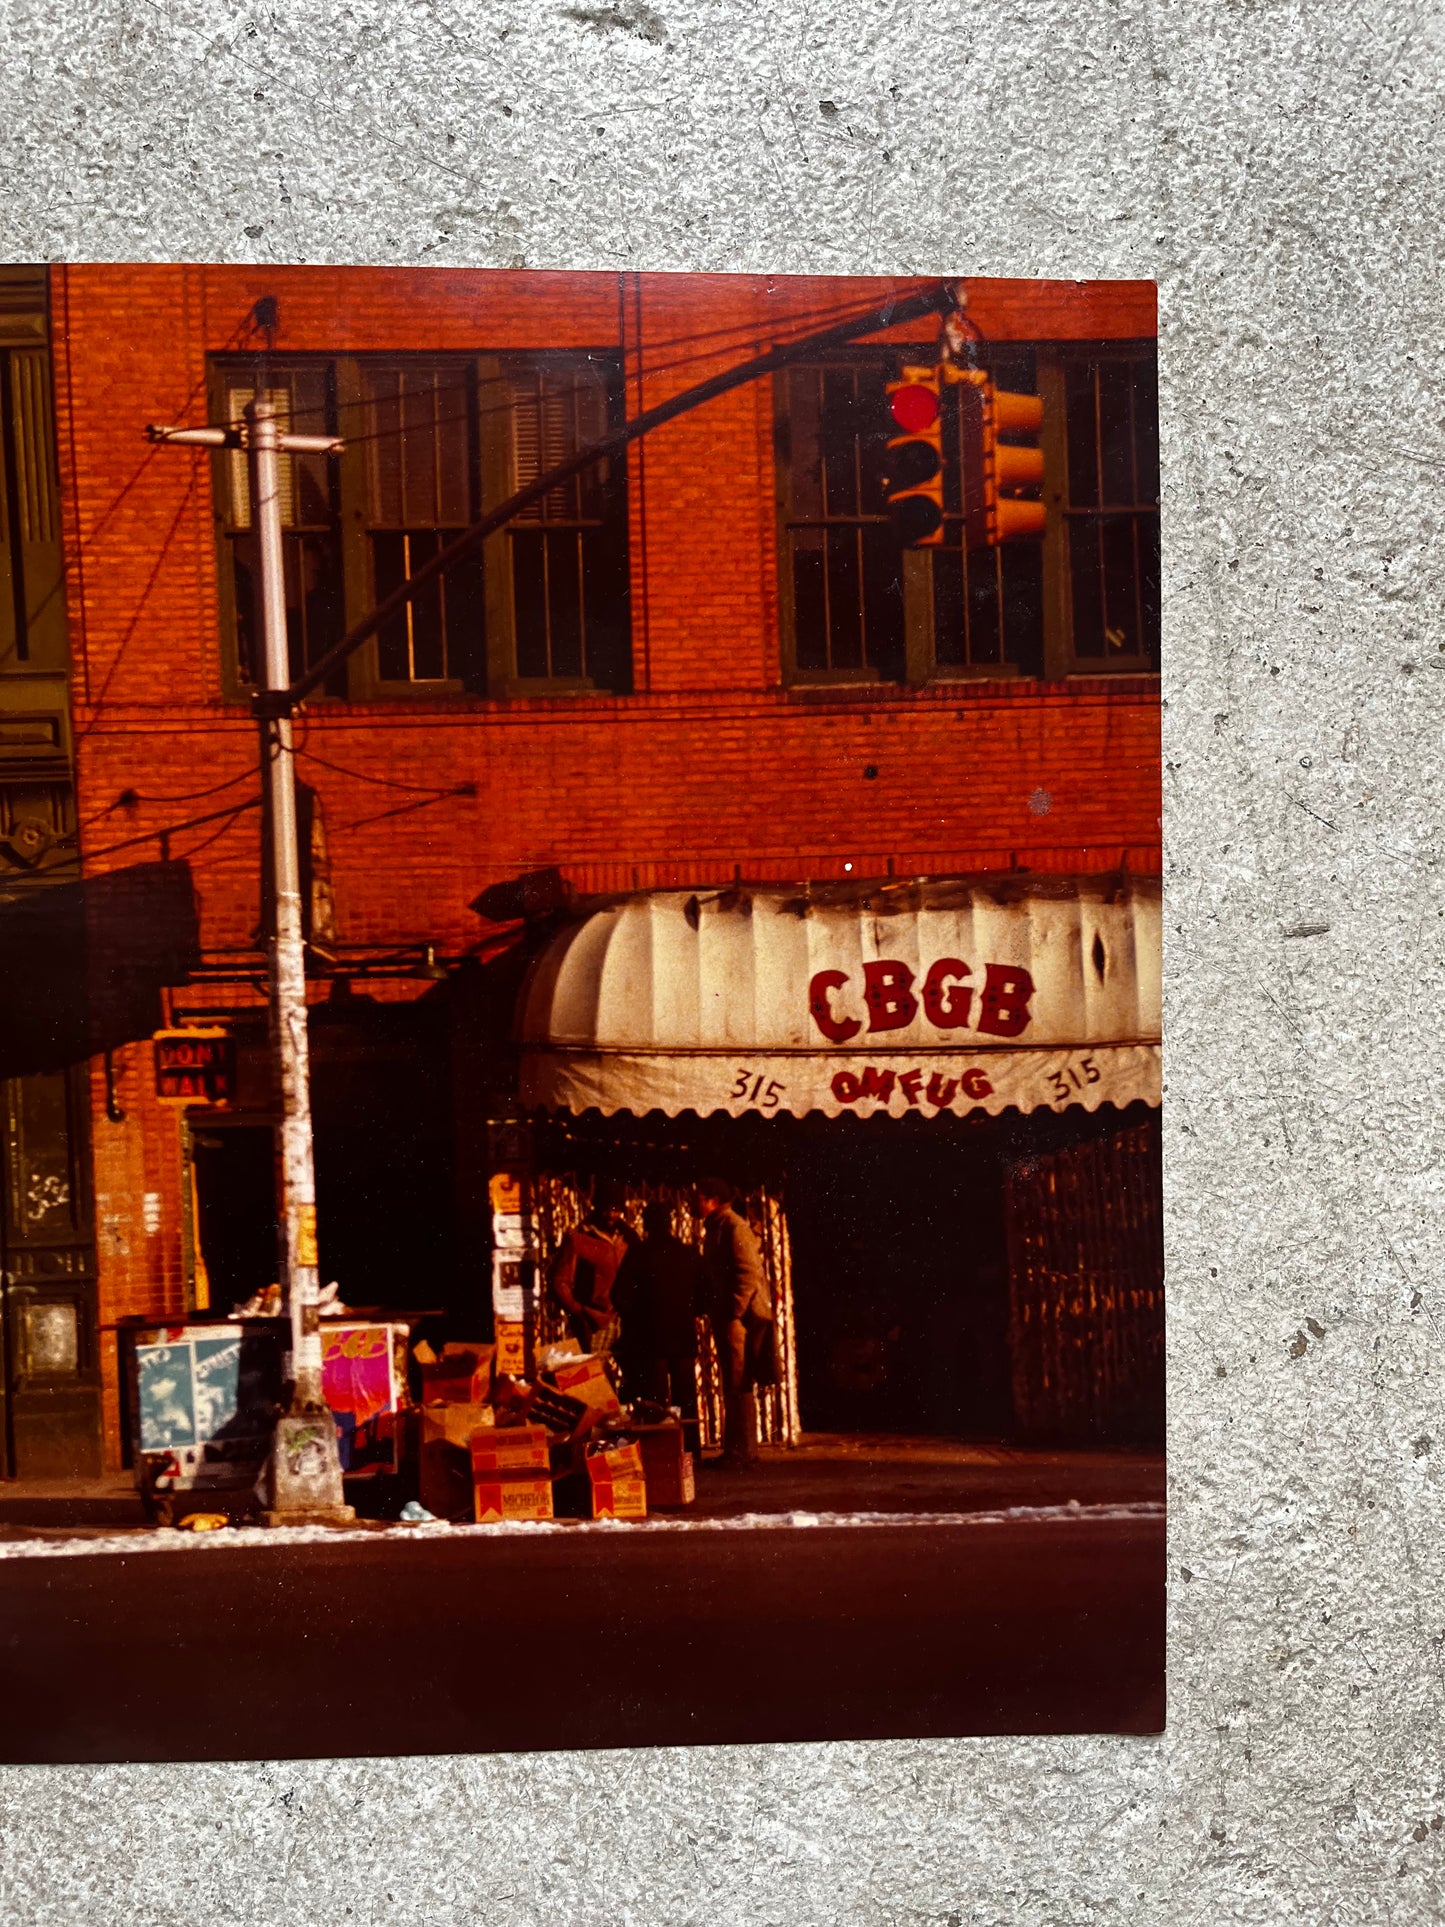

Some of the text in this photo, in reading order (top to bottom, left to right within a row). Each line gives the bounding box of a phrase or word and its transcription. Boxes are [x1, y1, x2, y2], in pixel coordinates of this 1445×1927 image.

[809, 957, 1036, 1044] CBGB
[730, 1056, 1101, 1108] 315 OMFUG 315
